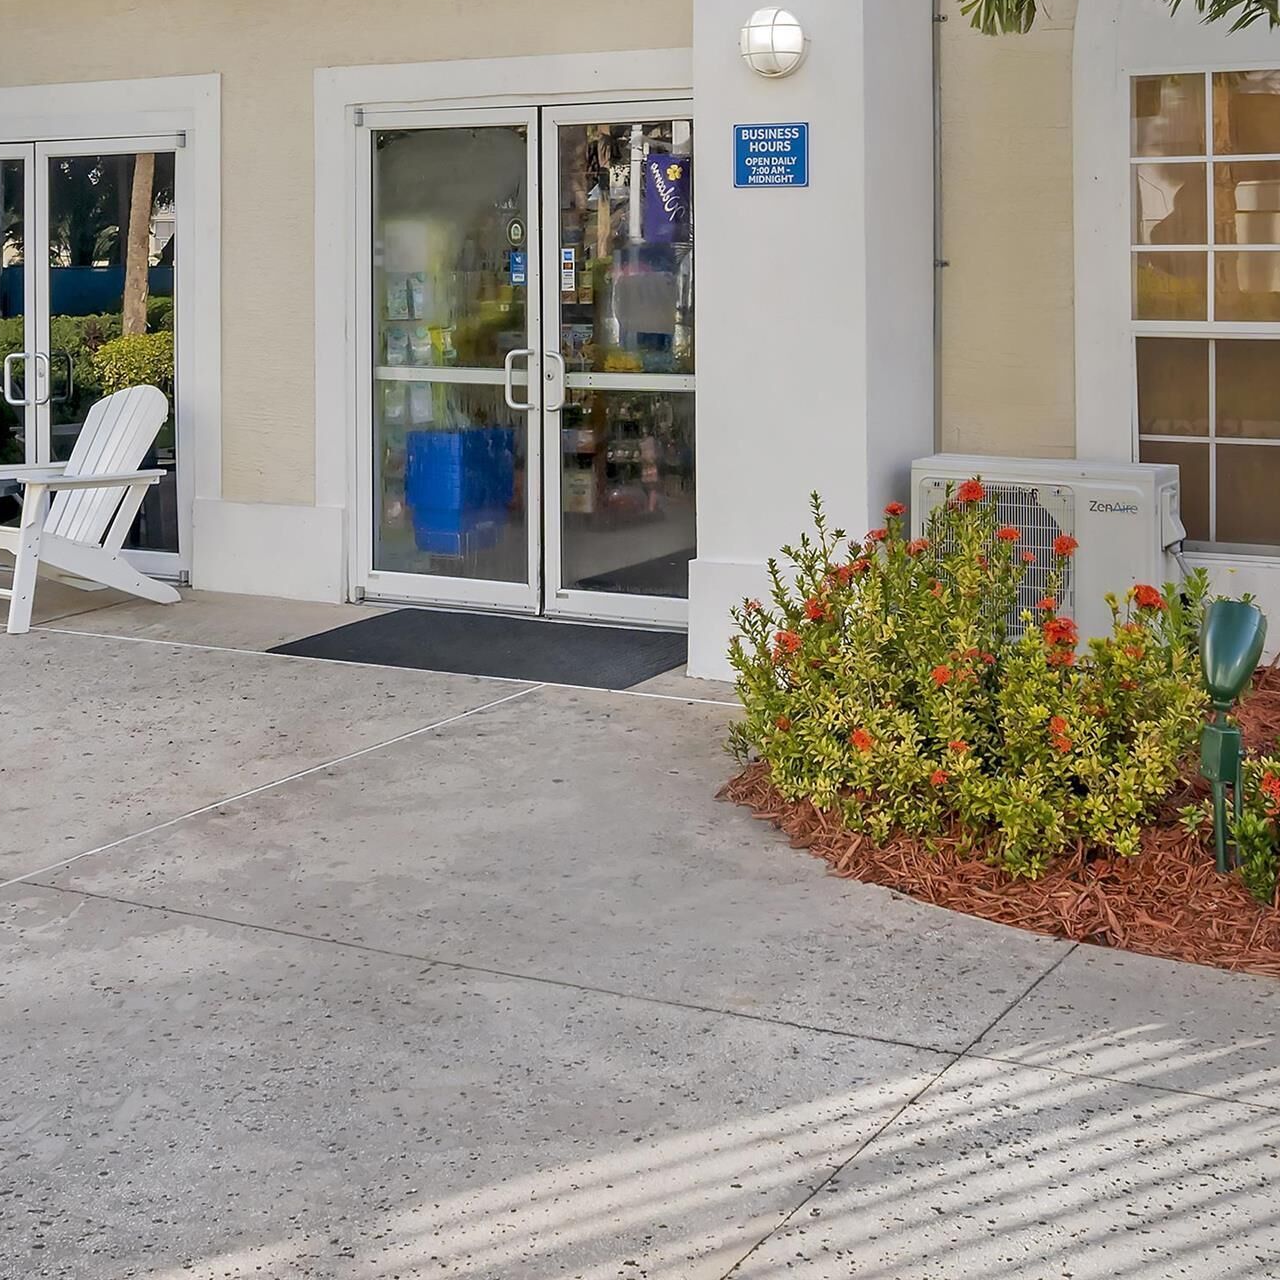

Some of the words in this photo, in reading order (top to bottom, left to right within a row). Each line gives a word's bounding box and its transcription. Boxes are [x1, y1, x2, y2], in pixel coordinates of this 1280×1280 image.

[741, 128, 799, 140] BUSINESS
[749, 141, 791, 152] HOURS
[745, 157, 770, 166] OPEN
[771, 156, 797, 165] DAILY
[751, 167, 770, 175] 7:00
[771, 166, 785, 174] AM
[748, 174, 794, 184] MIDNIGHT
[1089, 500, 1138, 515] ZenAire
